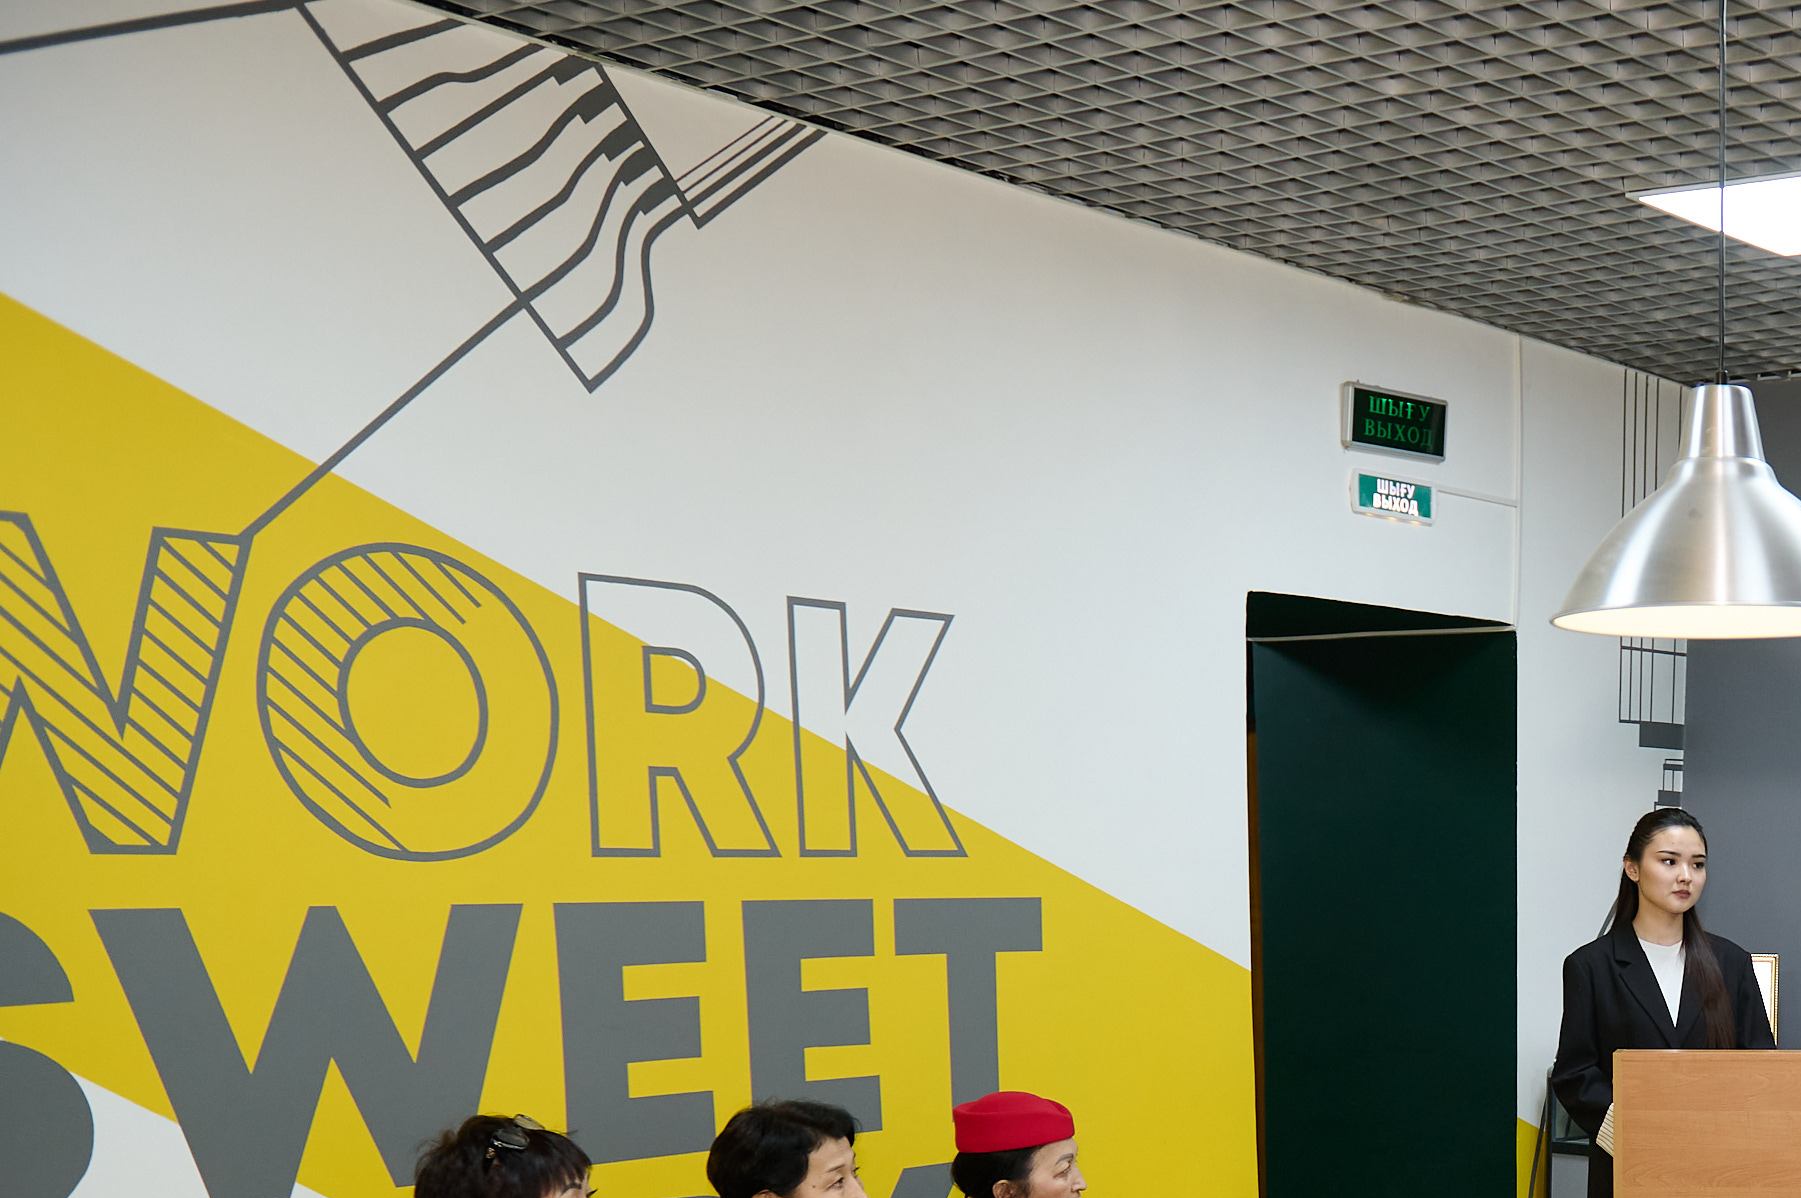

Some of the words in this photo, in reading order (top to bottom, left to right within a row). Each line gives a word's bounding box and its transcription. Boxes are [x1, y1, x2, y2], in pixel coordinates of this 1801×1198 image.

[1369, 396, 1431, 421] ШЫҒУ
[1364, 418, 1433, 448] ВЫХОД
[1376, 478, 1416, 499] ШЫҒУ
[1372, 493, 1419, 517] ВЫХОД
